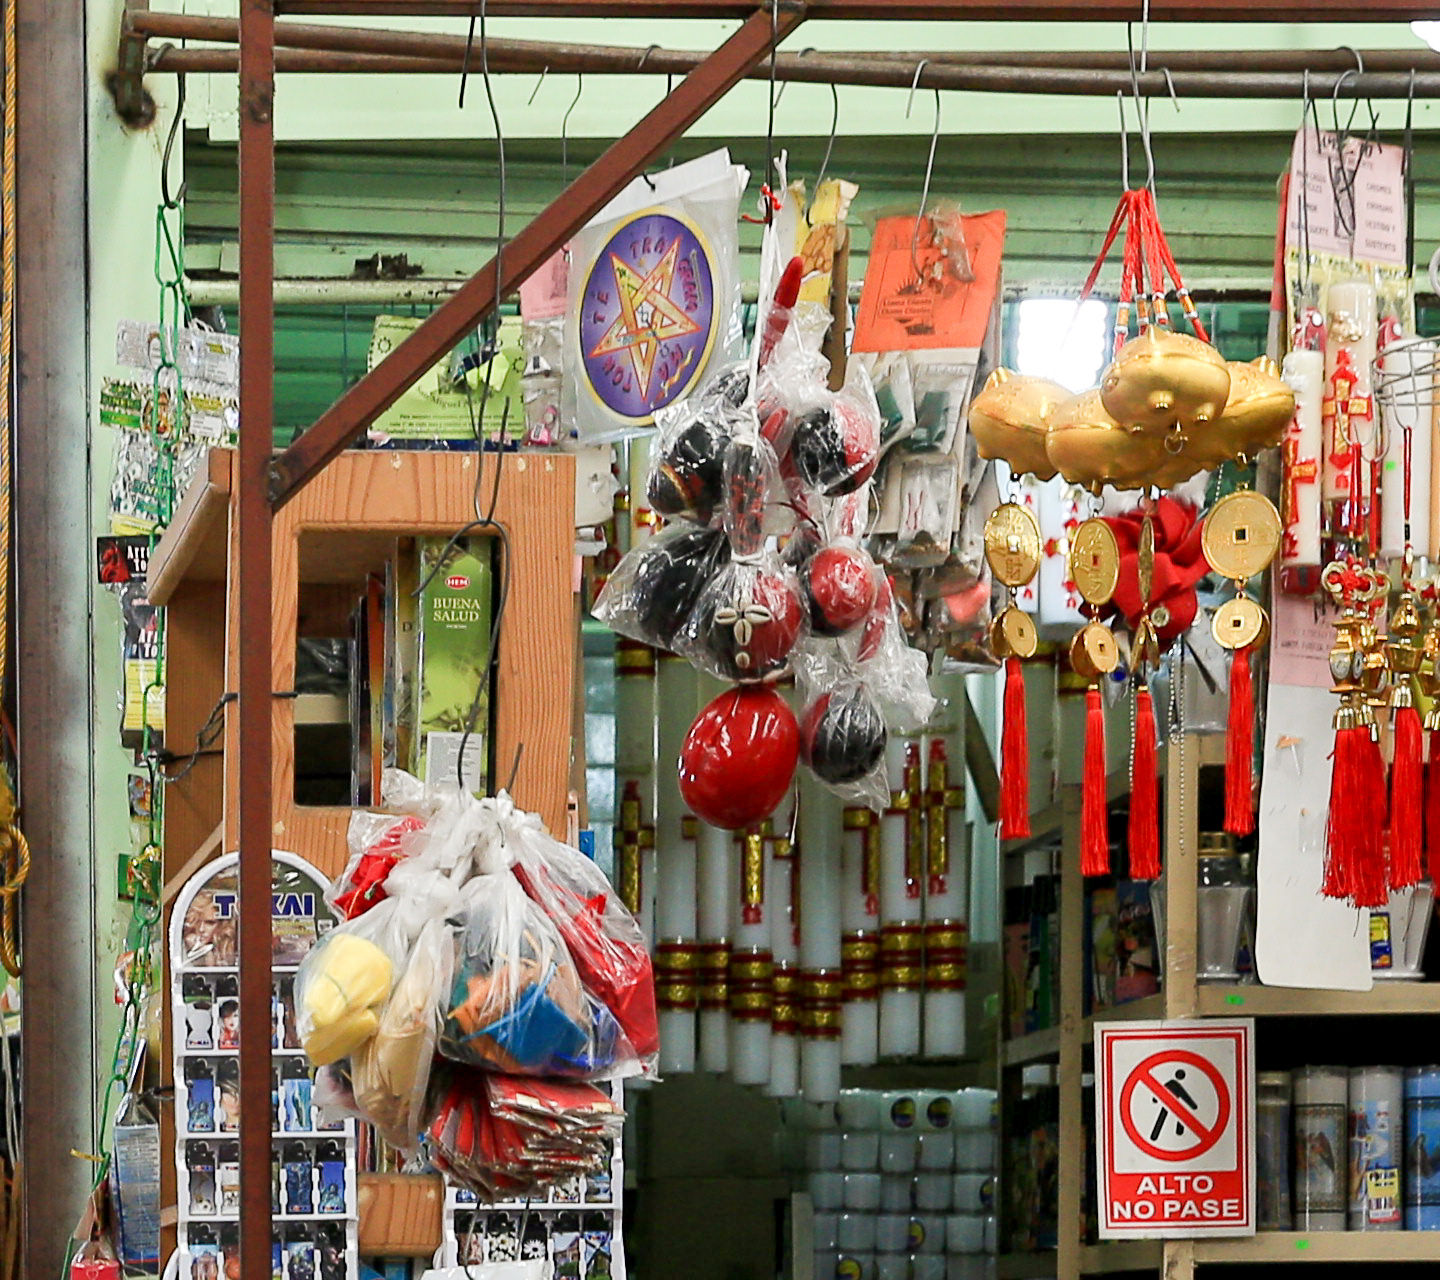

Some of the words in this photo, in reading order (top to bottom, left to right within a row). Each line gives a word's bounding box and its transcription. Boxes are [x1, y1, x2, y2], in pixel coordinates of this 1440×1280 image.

[446, 577, 468, 587] HEM
[433, 597, 481, 611] BUENA
[433, 610, 480, 623] SALUD
[214, 894, 315, 917] TKAI
[1136, 1175, 1214, 1195] ALTO
[1113, 1200, 1156, 1219] NO
[1163, 1198, 1241, 1219] PASE
